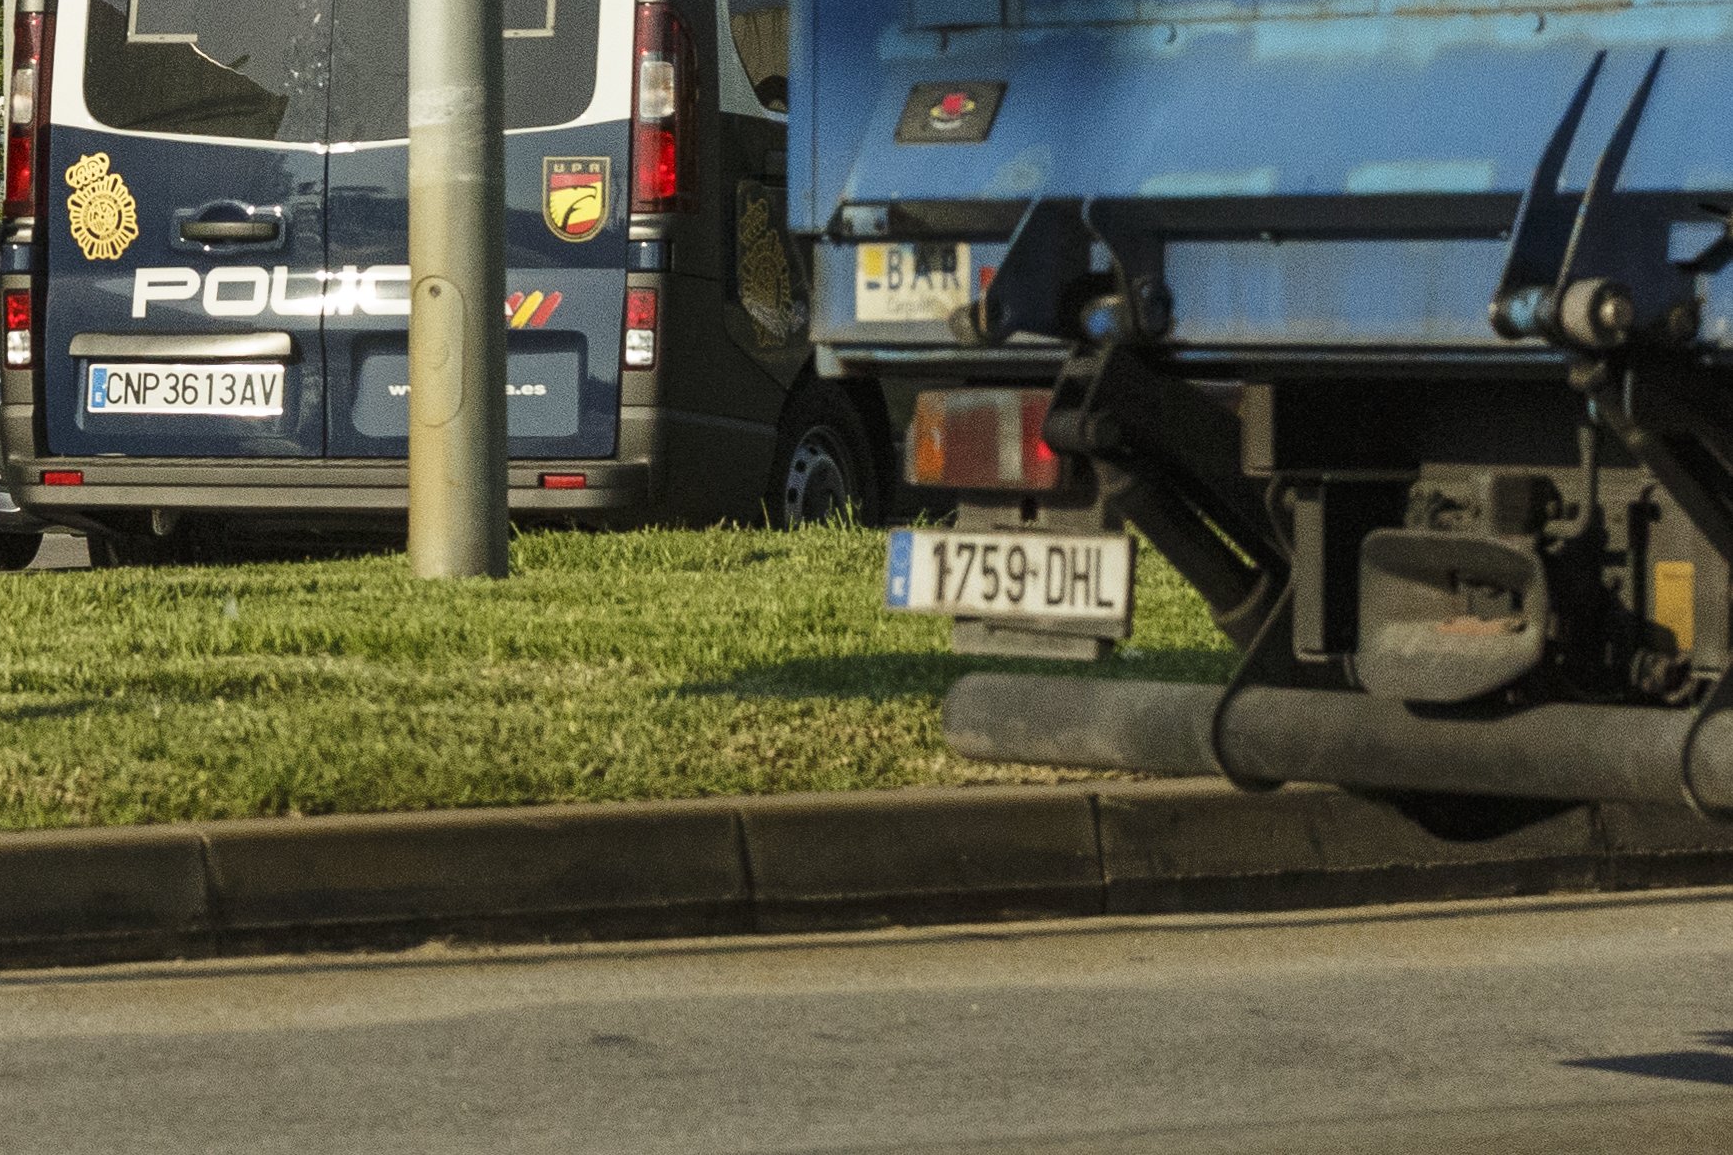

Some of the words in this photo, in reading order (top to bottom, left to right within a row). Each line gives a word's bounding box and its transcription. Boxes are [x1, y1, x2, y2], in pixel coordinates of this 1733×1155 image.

[131, 265, 411, 318] POLIC
[934, 541, 1027, 603] 1759
[1045, 546, 1114, 608] DHL
